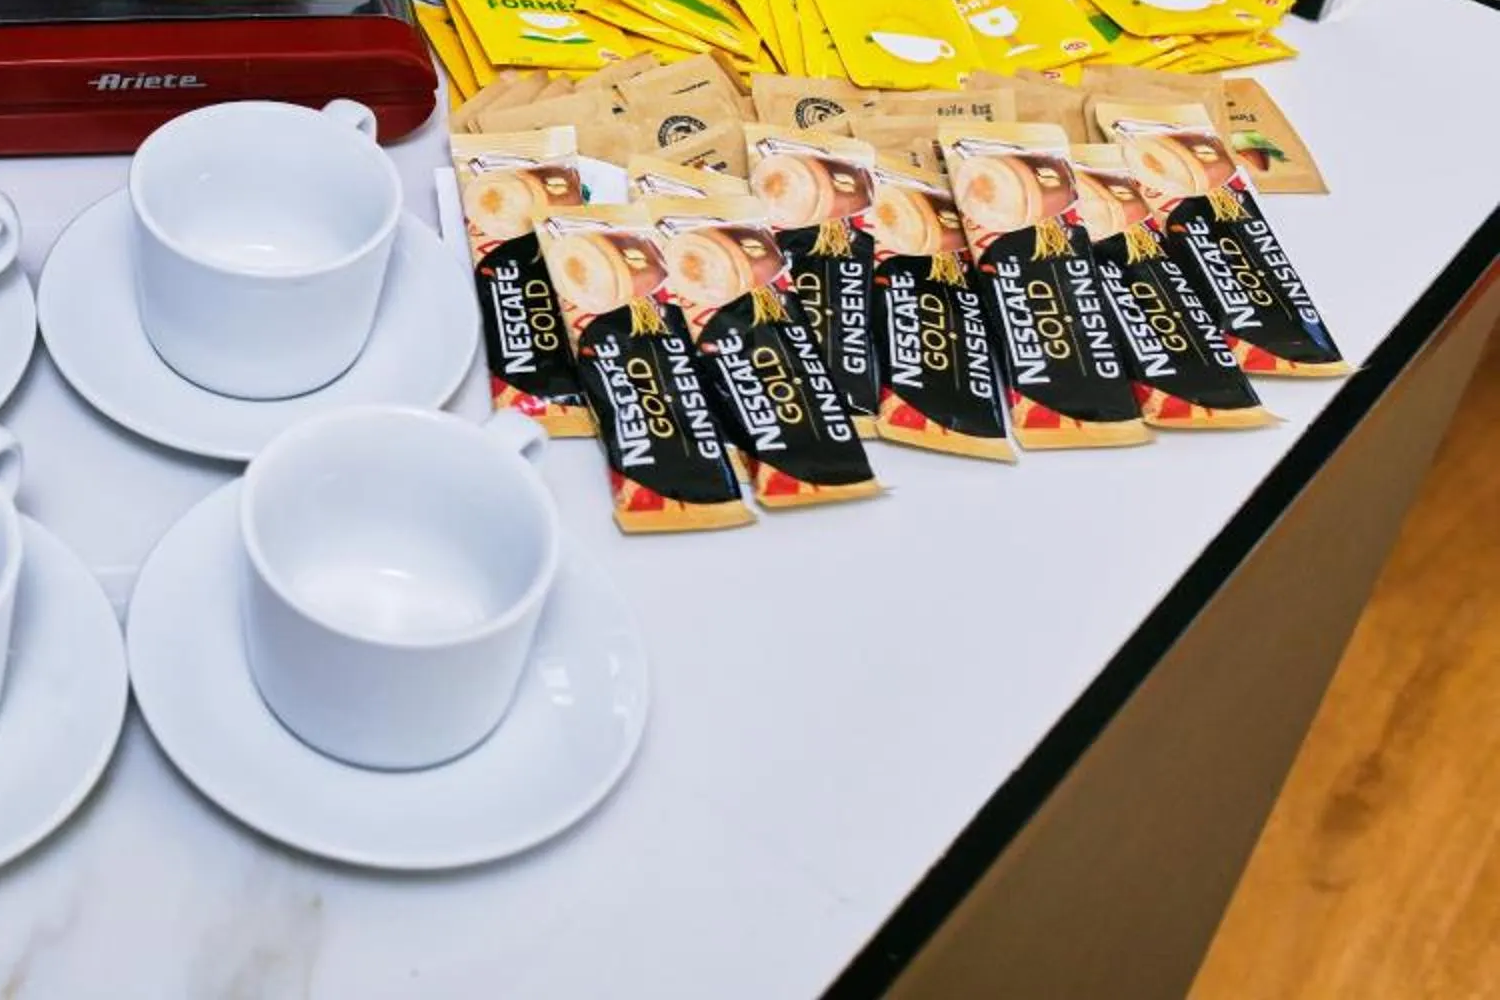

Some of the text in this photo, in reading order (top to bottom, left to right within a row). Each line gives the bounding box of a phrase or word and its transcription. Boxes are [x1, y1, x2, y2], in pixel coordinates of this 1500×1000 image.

[87, 73, 207, 91] Ariete
[1220, 237, 1273, 306] GOLD
[1244, 221, 1319, 324] GINSENG
[525, 279, 559, 351] GOLD
[840, 261, 867, 374] GINSENG
[920, 293, 949, 371] GOLD
[956, 291, 992, 398] GINSENG
[1028, 280, 1071, 359] GOLD
[1066, 259, 1120, 379] GINSENG
[1131, 281, 1188, 352] GOLD
[1161, 260, 1237, 367] GINSENG
[627, 357, 674, 438] GOLD
[662, 337, 721, 459] GINSENG
[753, 346, 803, 424] GOLD
[785, 325, 852, 442] GINSENG
